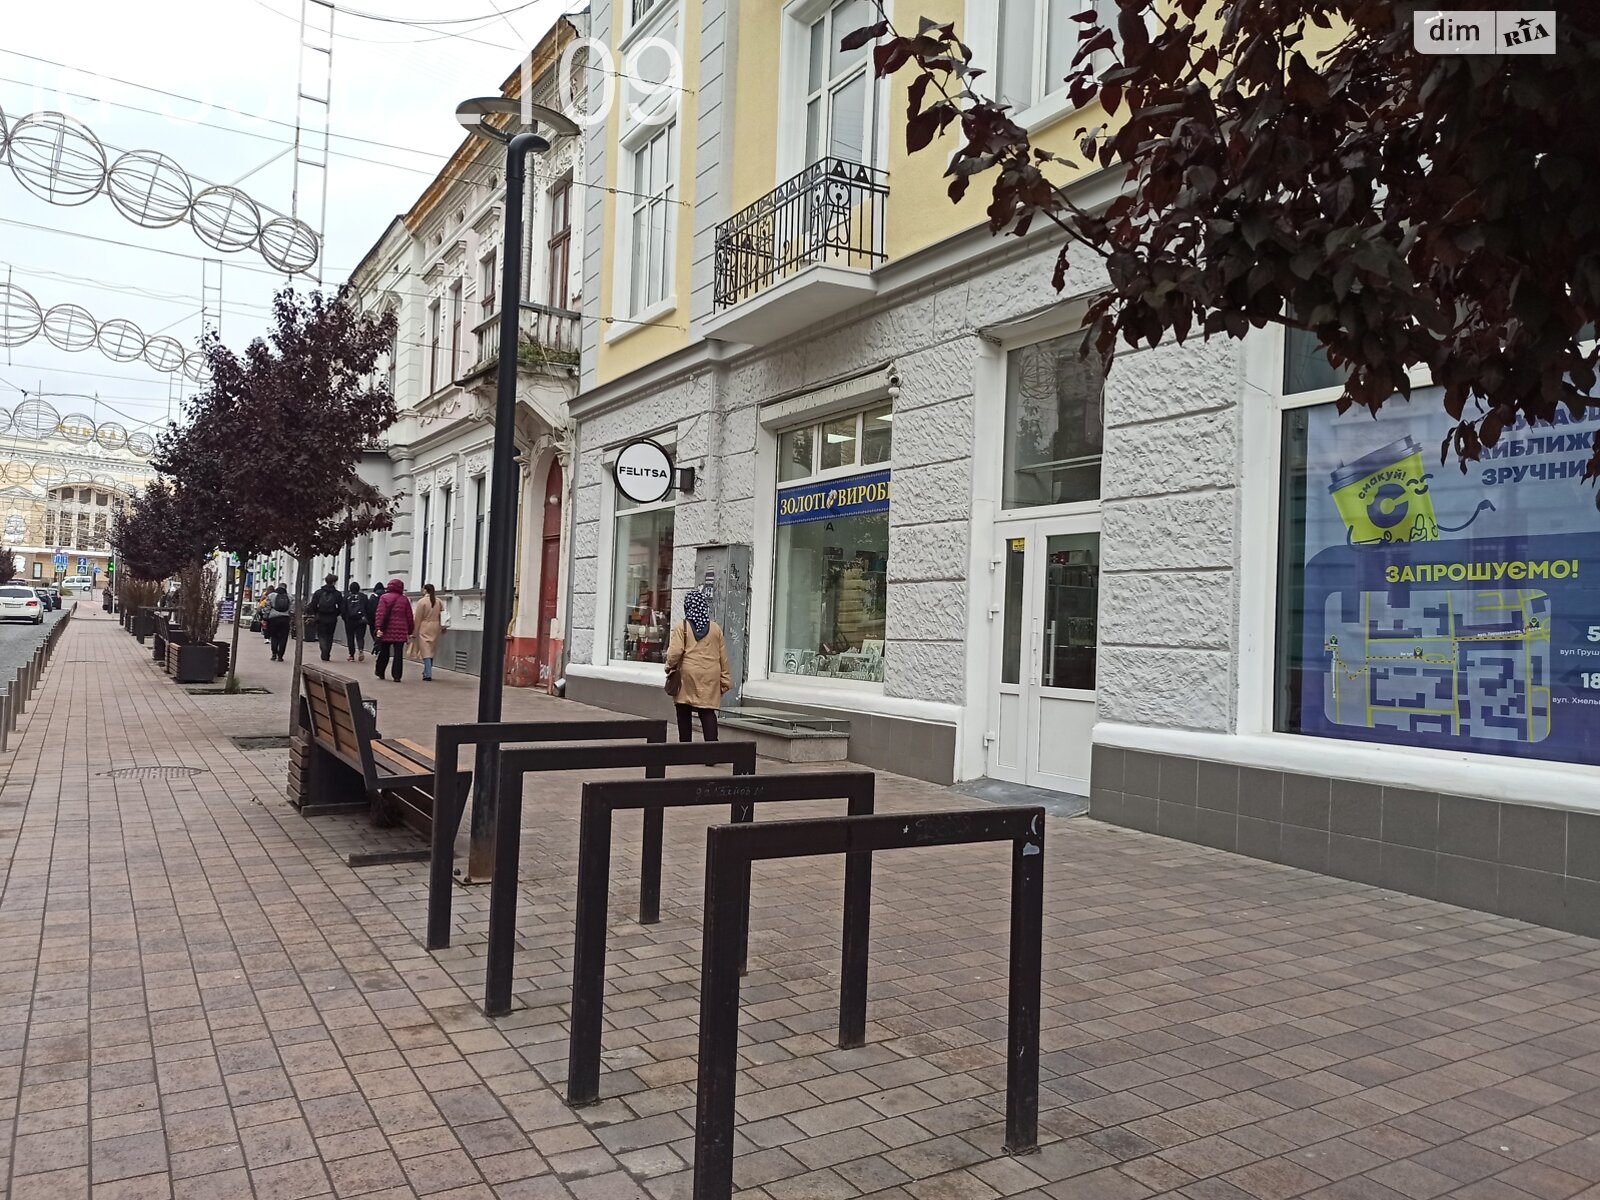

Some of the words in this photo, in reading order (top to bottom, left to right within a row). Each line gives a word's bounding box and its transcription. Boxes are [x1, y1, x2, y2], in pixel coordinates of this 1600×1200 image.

[619, 466, 668, 479] FELITSA
[780, 492, 826, 515] ЗОЛОТІ
[1385, 559, 1579, 583] ЗАПРОШУЄМО!
